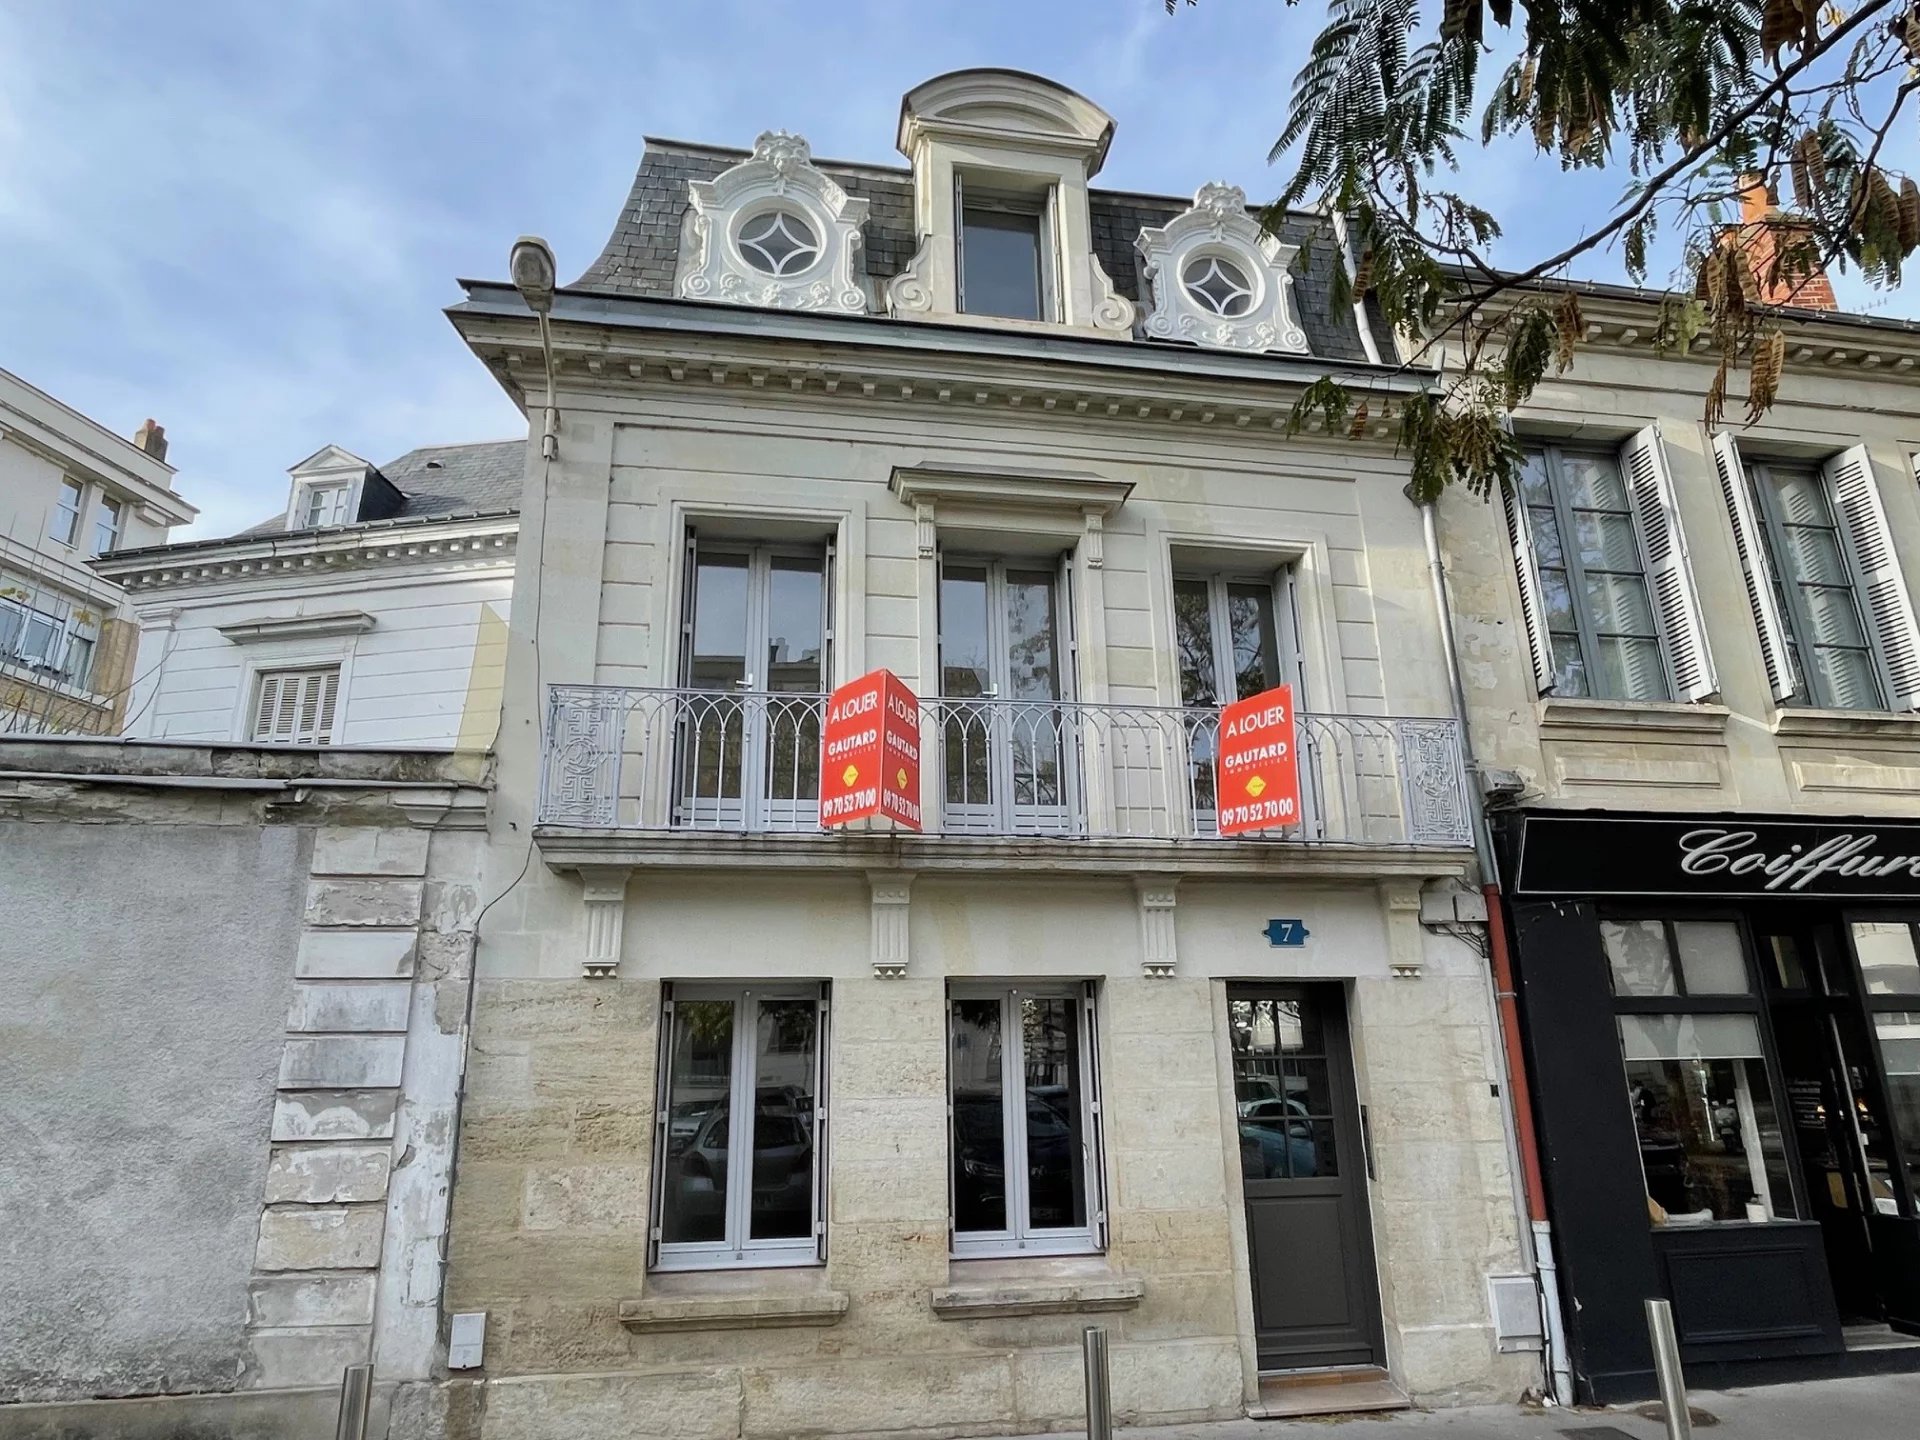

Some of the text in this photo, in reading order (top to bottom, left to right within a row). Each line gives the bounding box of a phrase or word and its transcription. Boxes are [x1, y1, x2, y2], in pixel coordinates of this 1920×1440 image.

[830, 690, 878, 724] A LOUER
[888, 693, 917, 730] A LOUER
[1226, 706, 1285, 739] A LOUER
[828, 729, 877, 756] GAUTARD
[886, 730, 918, 760] GAUTARD
[1225, 742, 1287, 768] GAUTARD
[833, 797, 844, 816] 70
[843, 793, 854, 813] 52
[855, 790, 865, 809] 70
[865, 788, 877, 807] 00
[1222, 797, 1293, 826] 09 70 52 70 00
[1281, 923, 1293, 942] 7
